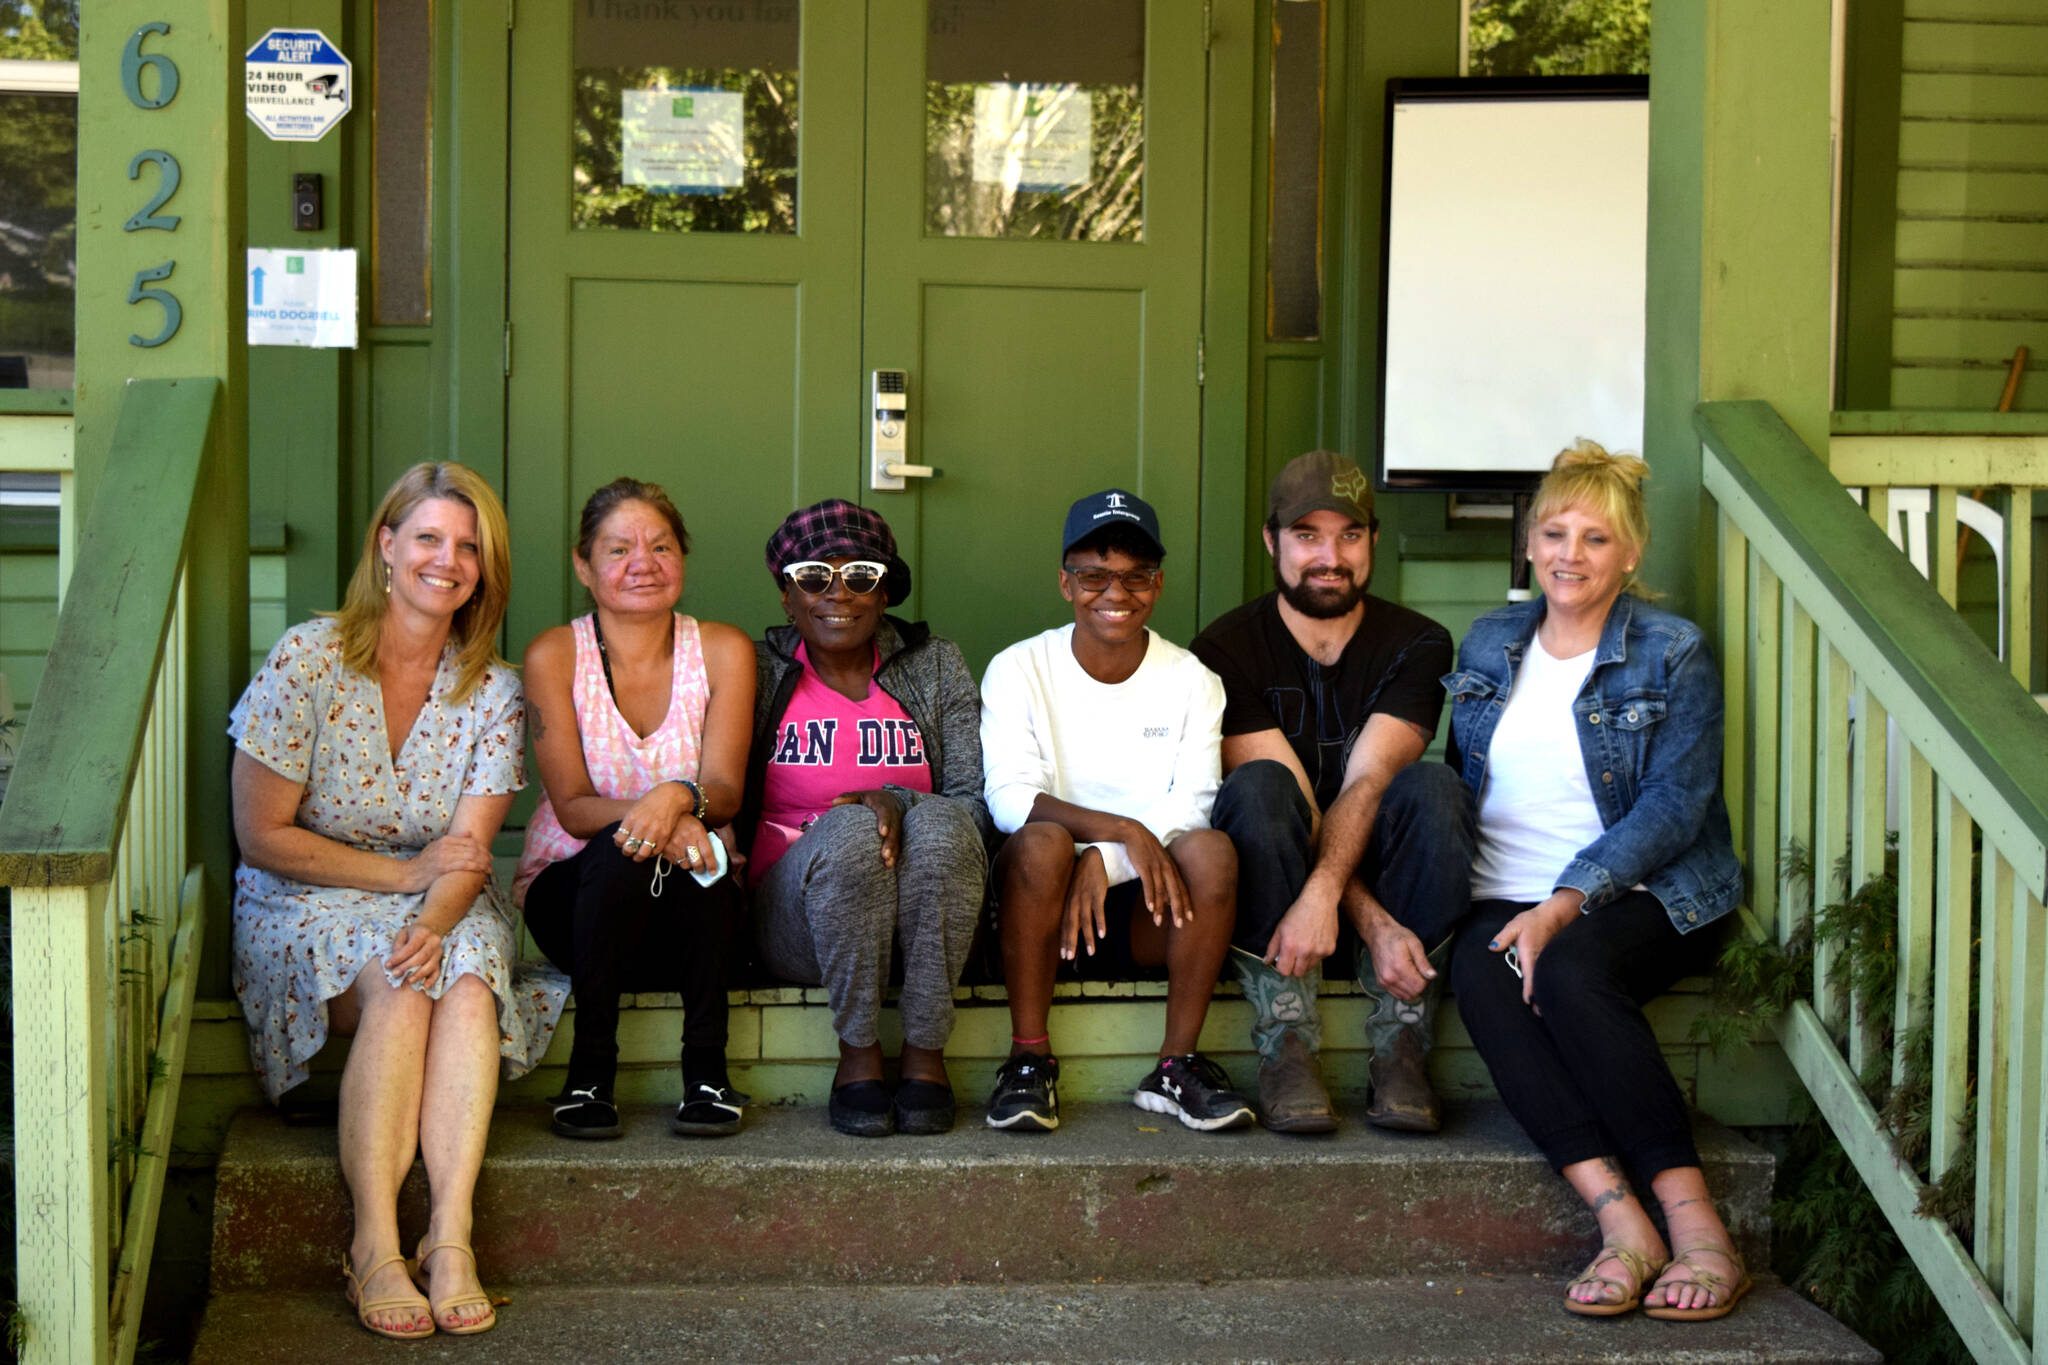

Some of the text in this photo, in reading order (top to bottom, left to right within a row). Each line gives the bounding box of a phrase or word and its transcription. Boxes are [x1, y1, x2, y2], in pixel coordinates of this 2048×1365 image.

[688, 3, 744, 28] you
[267, 38, 323, 52] SECURITY
[277, 51, 314, 63] ALERT
[247, 71, 304, 82] 24 HOUR
[247, 84, 288, 94] VIDEO
[246, 96, 316, 106] SURVEILLANCE
[247, 309, 277, 320] RING
[857, 718, 930, 767] DIE
